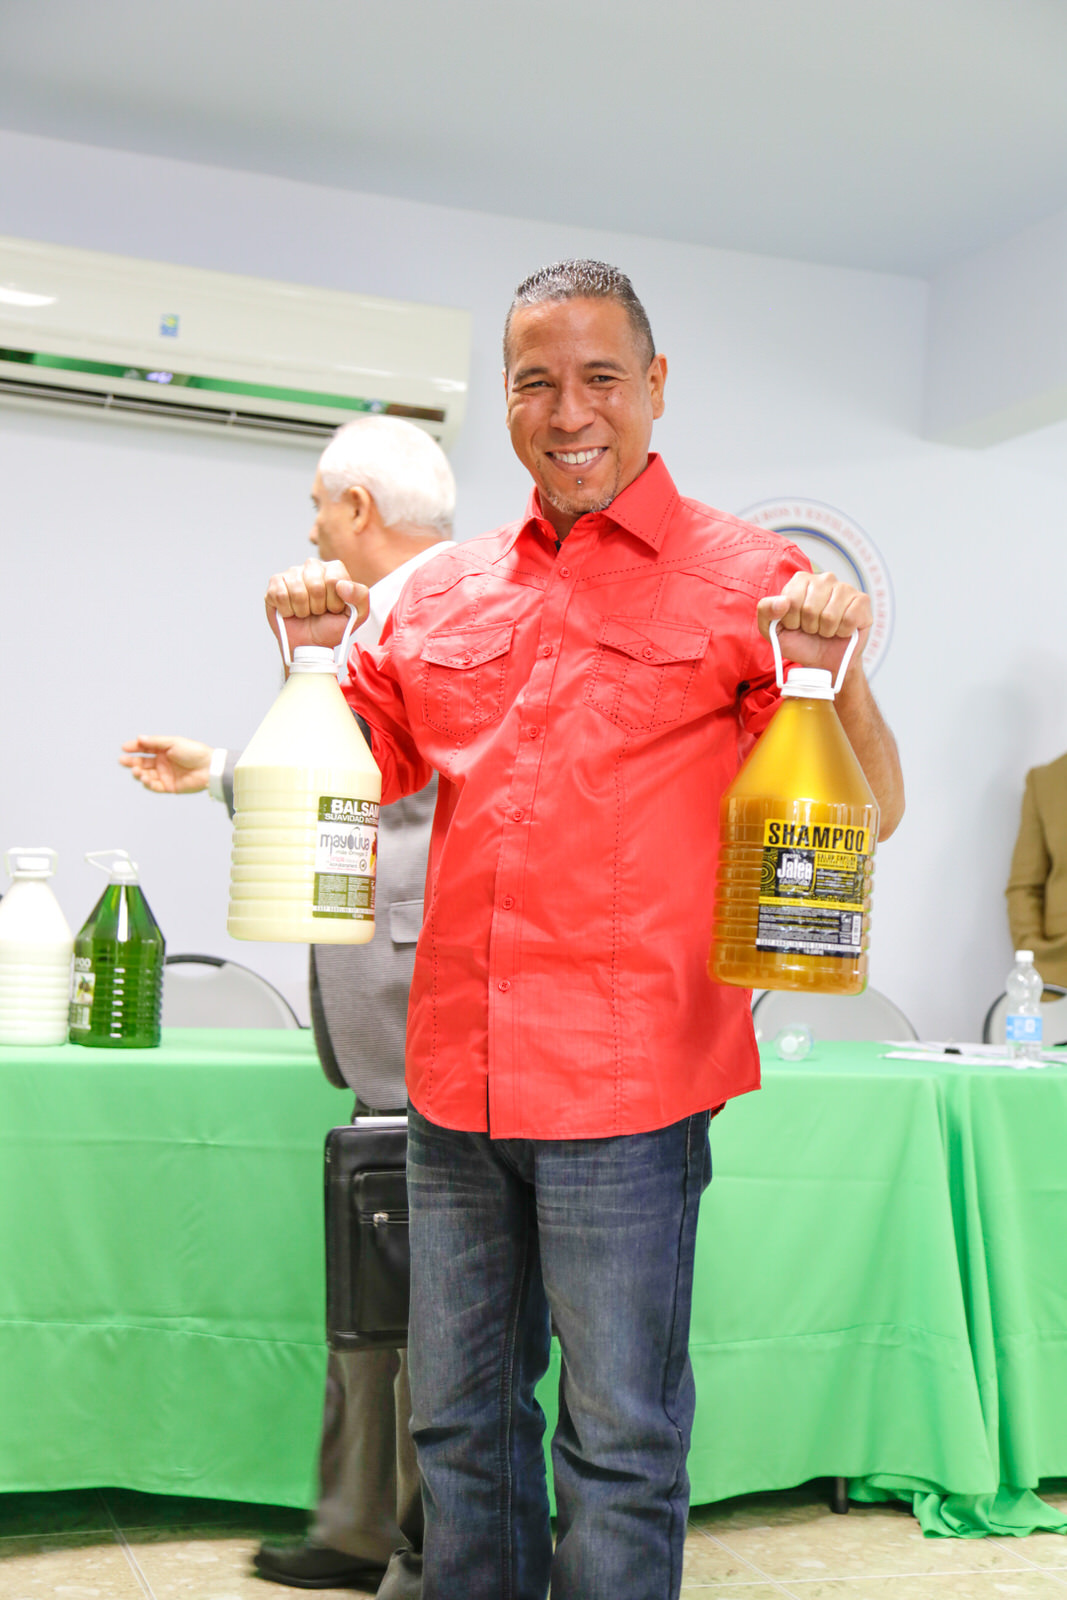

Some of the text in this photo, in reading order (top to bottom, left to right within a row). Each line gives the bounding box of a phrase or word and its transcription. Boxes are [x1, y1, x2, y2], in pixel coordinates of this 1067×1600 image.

[324, 812, 364, 823] SUAVIDAD
[768, 822, 865, 852] SHAMPOO
[777, 856, 813, 881] Jalea
